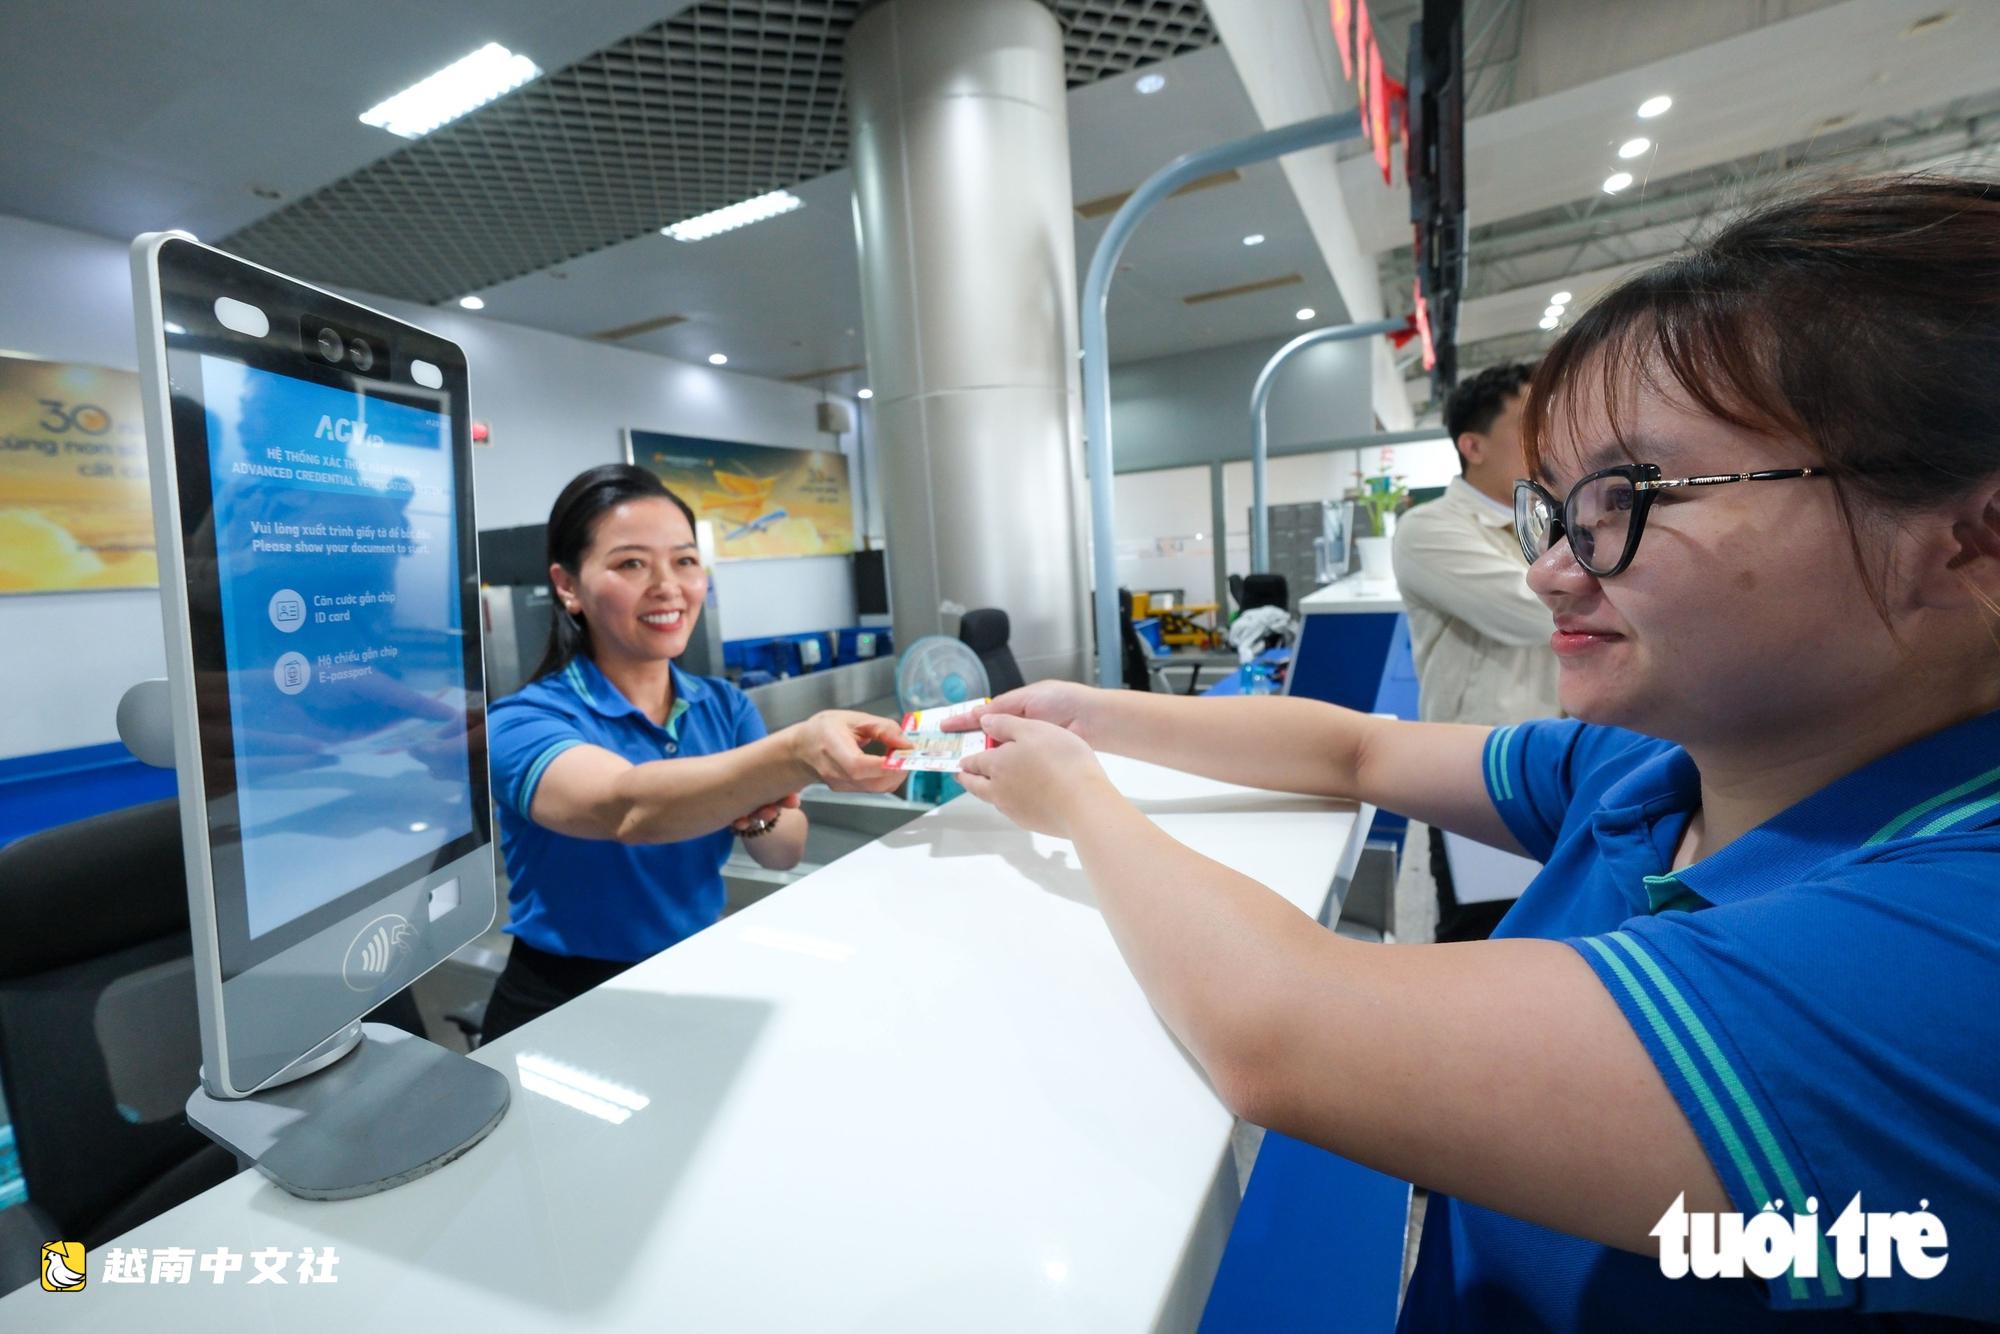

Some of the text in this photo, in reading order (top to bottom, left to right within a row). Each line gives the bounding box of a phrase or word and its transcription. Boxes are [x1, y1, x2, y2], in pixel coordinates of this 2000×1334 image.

[38, 399, 112, 436] 30
[314, 415, 368, 445] ACV
[267, 447, 282, 463] HỆ
[284, 449, 320, 465] THỐNG
[322, 454, 342, 468] XÁC
[232, 461, 293, 479] ADVANCED
[295, 470, 356, 486] CREDENTIAL
[250, 521, 271, 534] Vui
[274, 522, 299, 538] lòng
[302, 523, 327, 536] xuất
[328, 524, 353, 537] trình
[356, 525, 375, 540] giấy
[377, 527, 387, 538] tờ
[252, 539, 292, 553] Please
[295, 540, 323, 553] show
[325, 543, 350, 556] your
[351, 542, 396, 553] document
[397, 543, 407, 553] to
[313, 590, 397, 607] Căn cước gắn chip
[315, 609, 351, 623] ID card
[318, 645, 398, 669] Hộ chiếu gắn chip
[319, 665, 373, 684] E-passport
